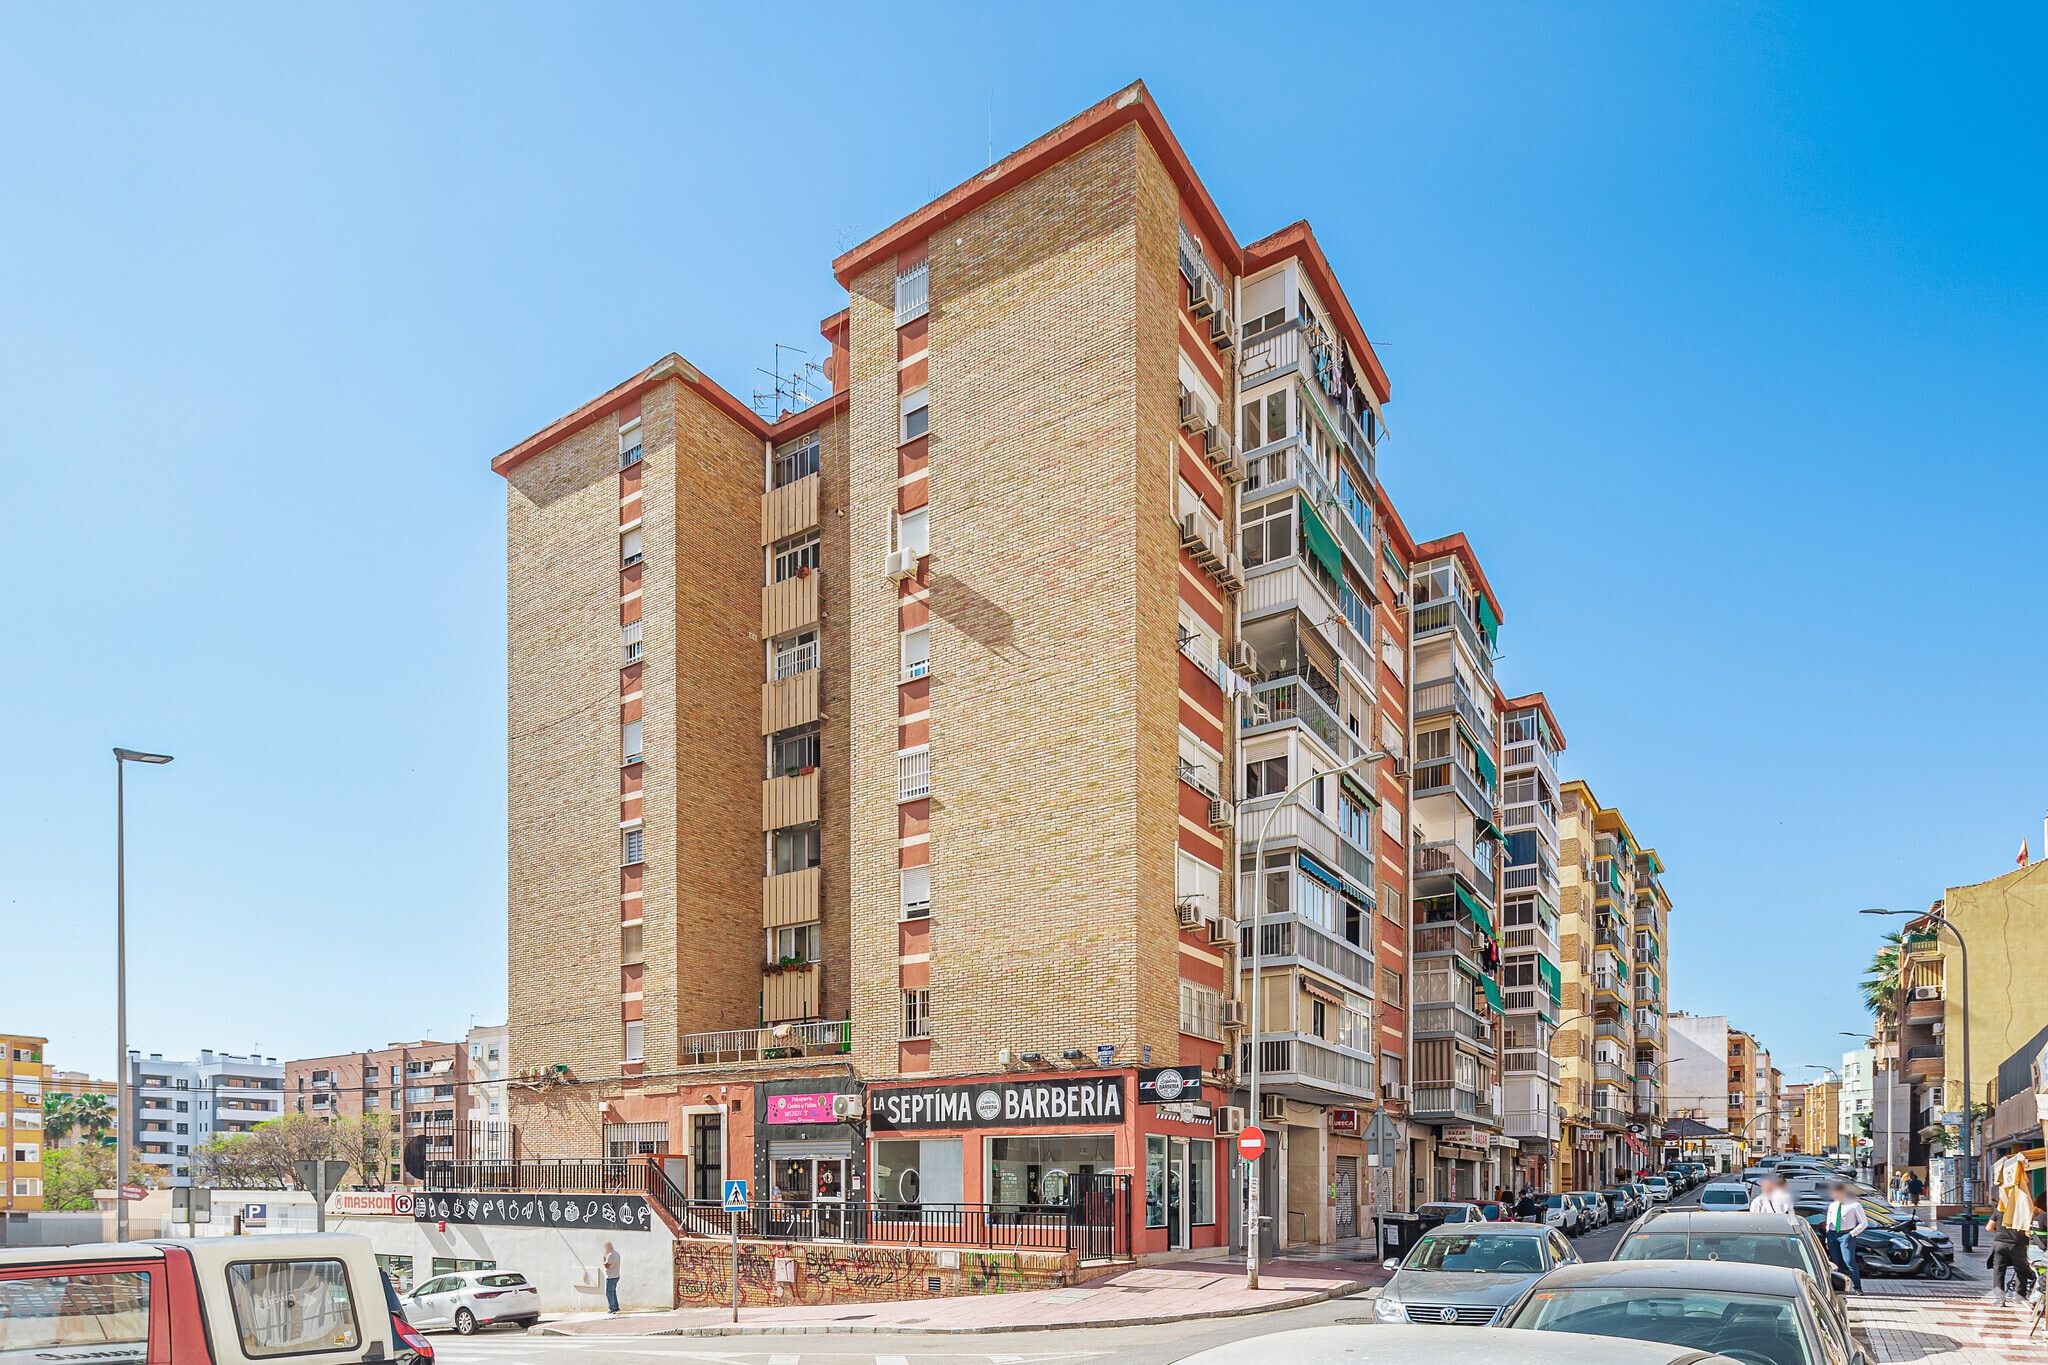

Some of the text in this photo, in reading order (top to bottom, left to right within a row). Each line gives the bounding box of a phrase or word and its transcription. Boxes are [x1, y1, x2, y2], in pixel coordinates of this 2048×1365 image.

[873, 1079, 1121, 1124] LA SEPTÍMA BARBERÍA
[344, 1196, 392, 1209] MASKOM
[249, 1205, 261, 1219] P
